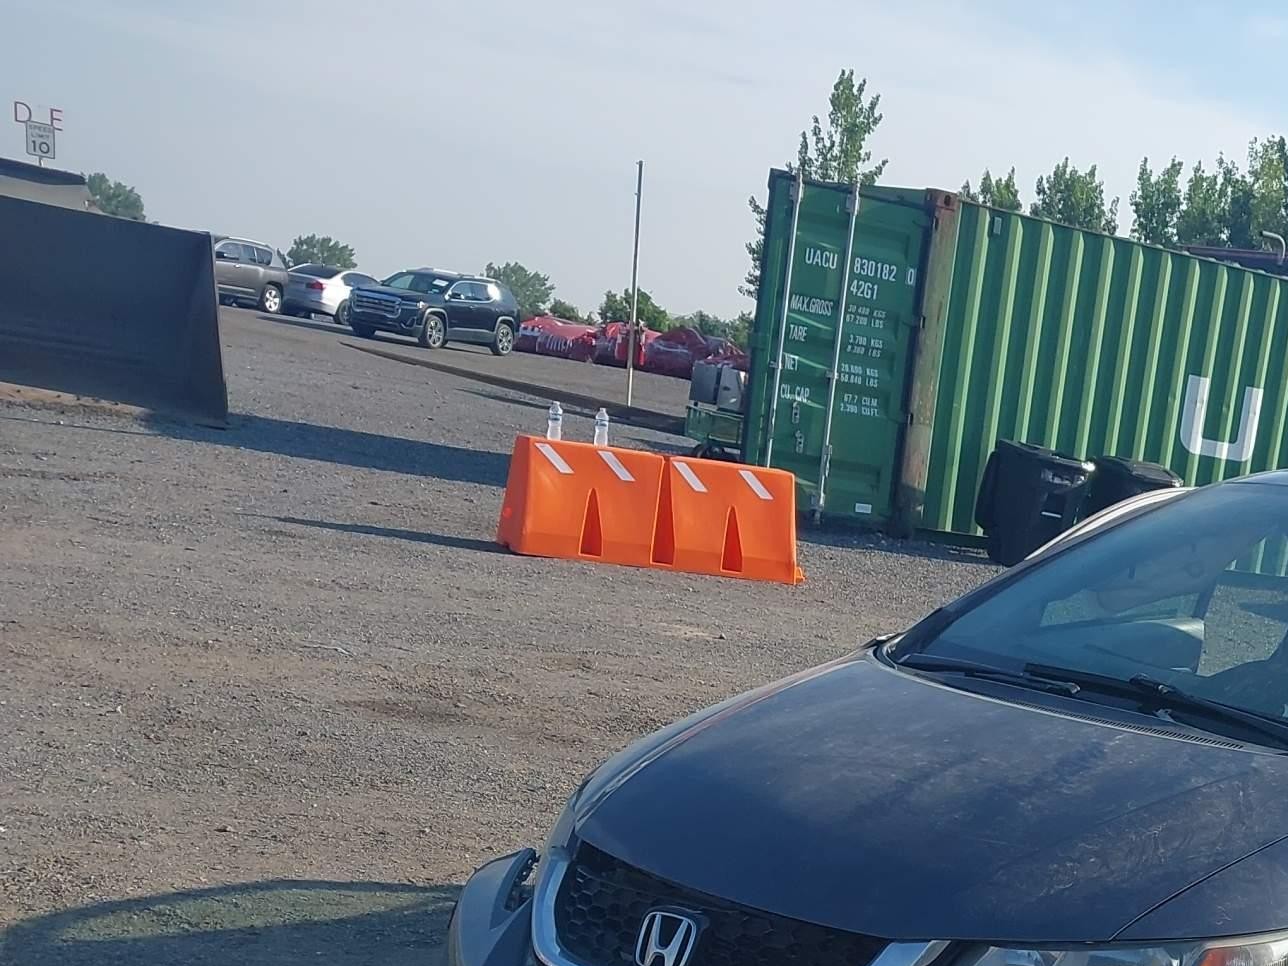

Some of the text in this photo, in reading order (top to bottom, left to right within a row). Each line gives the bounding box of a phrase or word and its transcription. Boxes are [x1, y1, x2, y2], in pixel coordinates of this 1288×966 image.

[32, 140, 50, 154] 10
[805, 248, 838, 269] UACU
[853, 257, 897, 282] 830182
[850, 279, 878, 300] 42G1
[789, 324, 808, 342] TARE
[784, 355, 799, 371] NET
[1180, 374, 1264, 462] U
